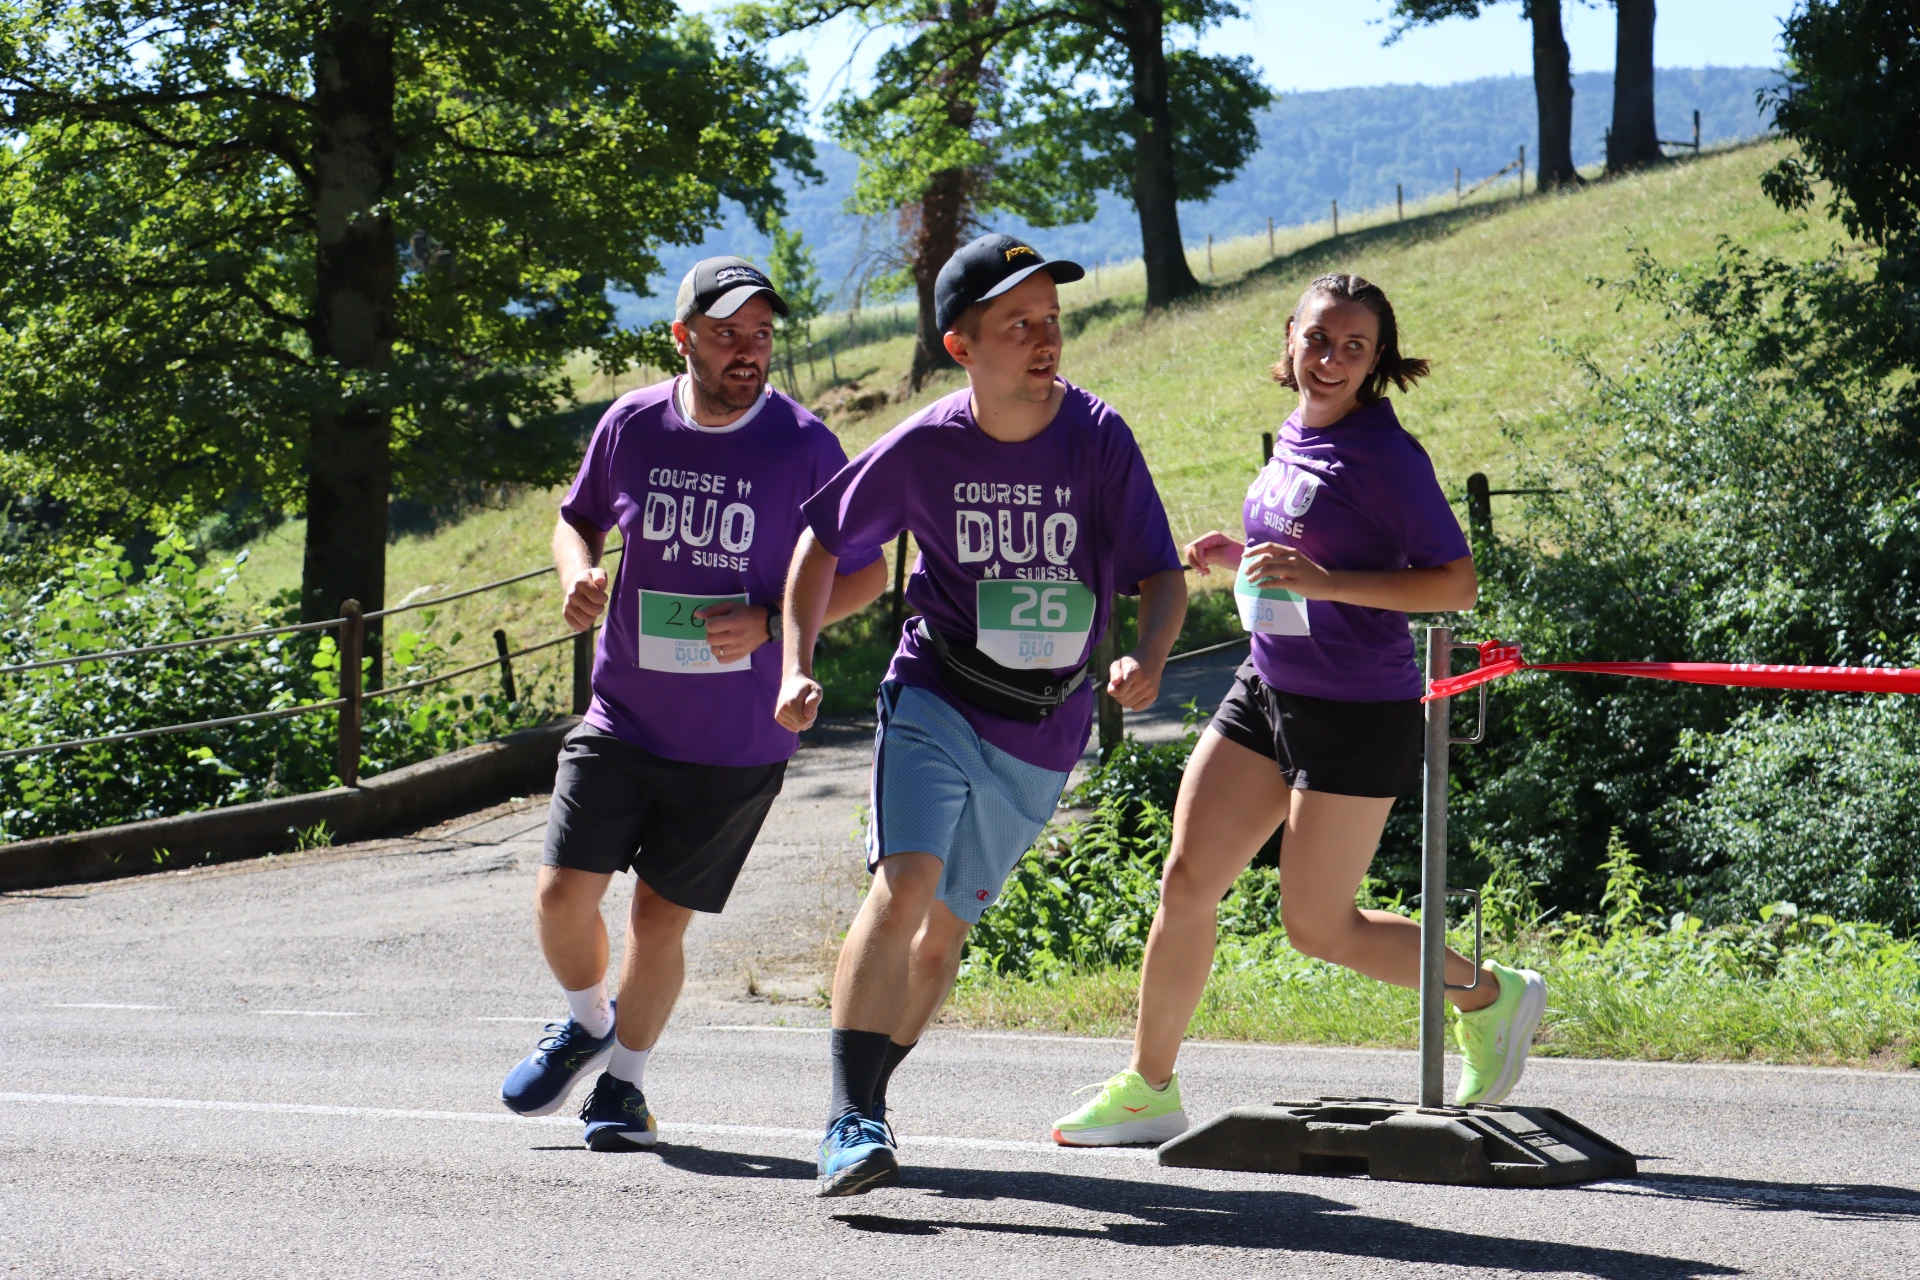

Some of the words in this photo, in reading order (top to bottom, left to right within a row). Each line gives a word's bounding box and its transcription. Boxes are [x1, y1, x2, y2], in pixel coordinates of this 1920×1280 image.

[649, 468, 727, 494] COURSE
[954, 483, 1042, 505] COURSE
[643, 492, 756, 553] DUO
[1263, 510, 1304, 539] SUISSE
[956, 509, 1078, 565] DUO
[691, 550, 750, 572] SUISSE
[666, 601, 706, 628] 26
[1010, 586, 1068, 627] 26
[675, 647, 711, 661] DUO
[1019, 640, 1054, 657] DUO
